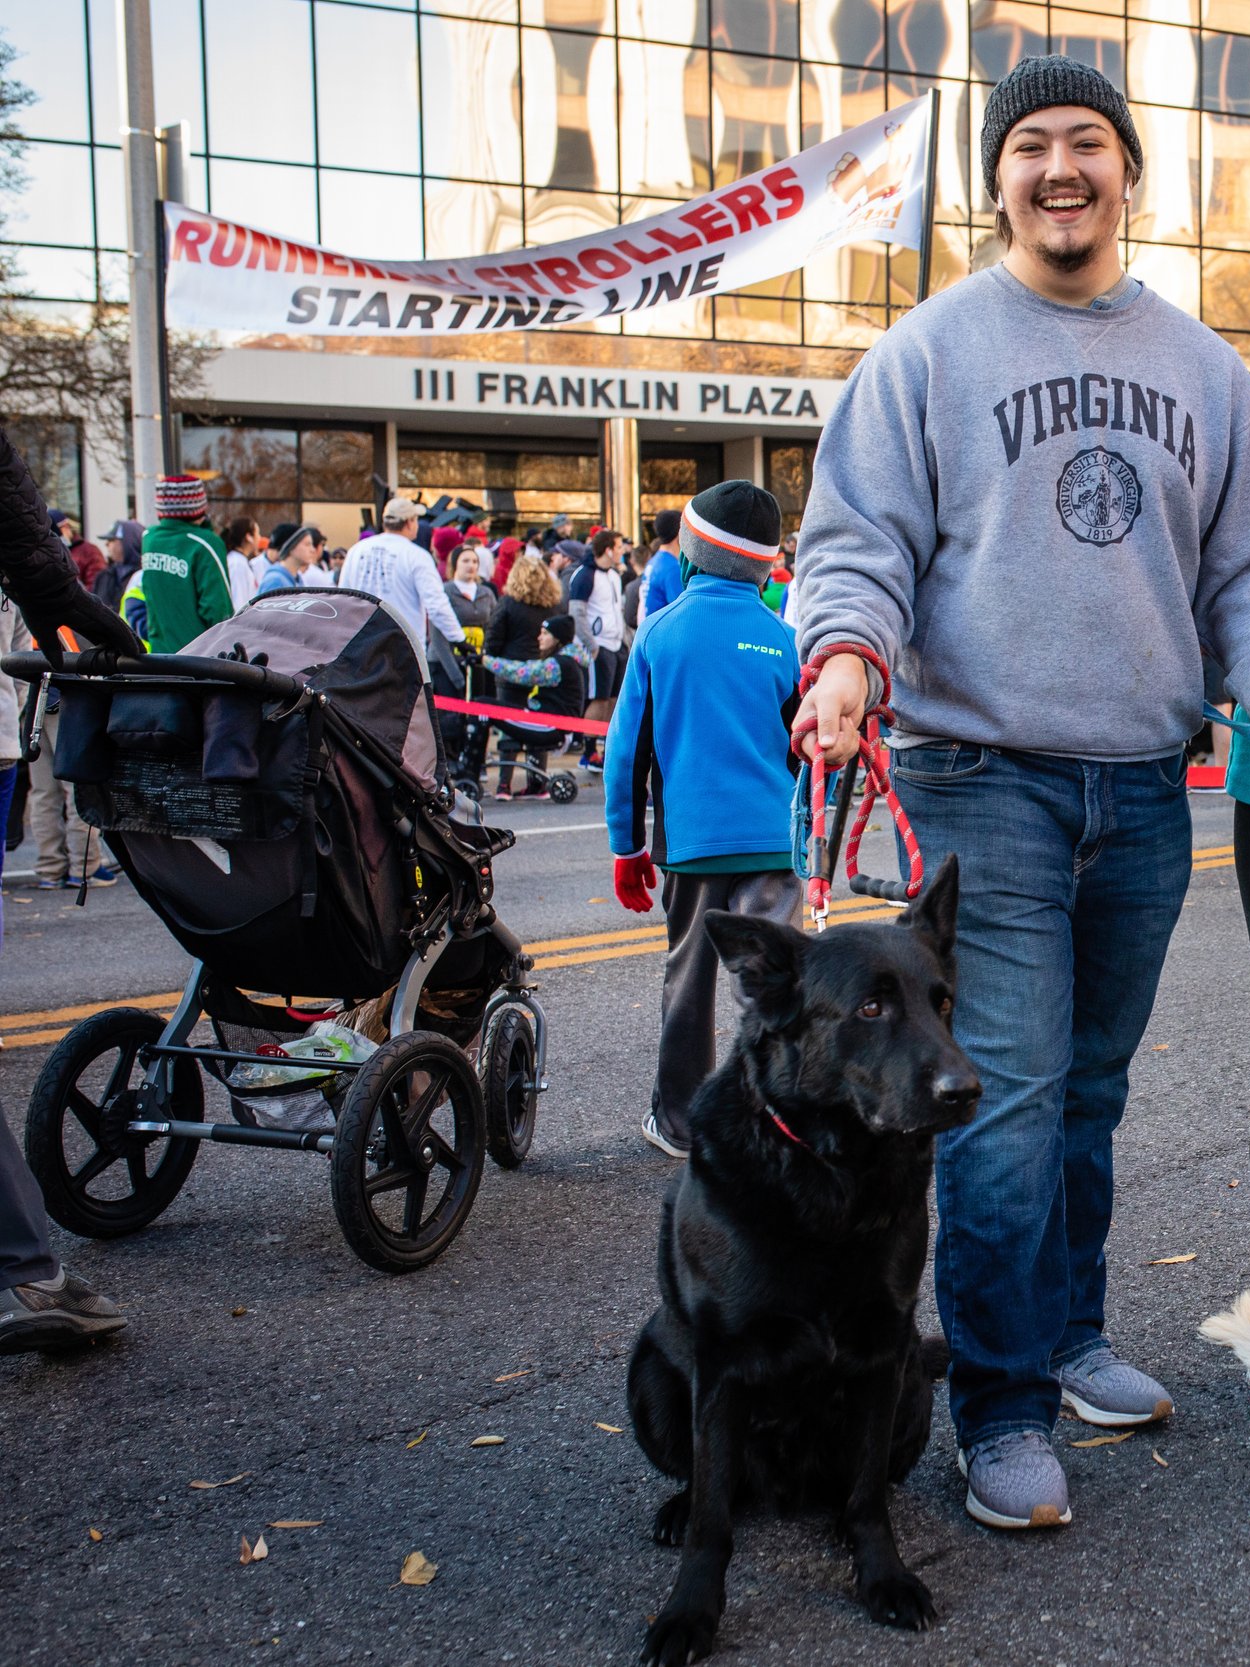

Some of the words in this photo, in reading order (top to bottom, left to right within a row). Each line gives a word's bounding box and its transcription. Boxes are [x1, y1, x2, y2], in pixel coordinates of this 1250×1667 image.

[172, 220, 410, 282] RUNNER
[475, 167, 804, 295] STROLLERS
[287, 286, 583, 329] STARTING
[596, 253, 725, 317] LINE
[477, 372, 679, 411] FRANKLIN
[700, 383, 819, 418] PLAZA
[993, 373, 1196, 490] VIRGINIA
[1061, 452, 1099, 519] UNIVERSITY
[1102, 454, 1117, 469] OF
[1117, 464, 1137, 523] VIRGINIA
[1086, 527, 1113, 541] 1819
[141, 552, 189, 578] ELTICS
[737, 642, 783, 658] SPYDER
